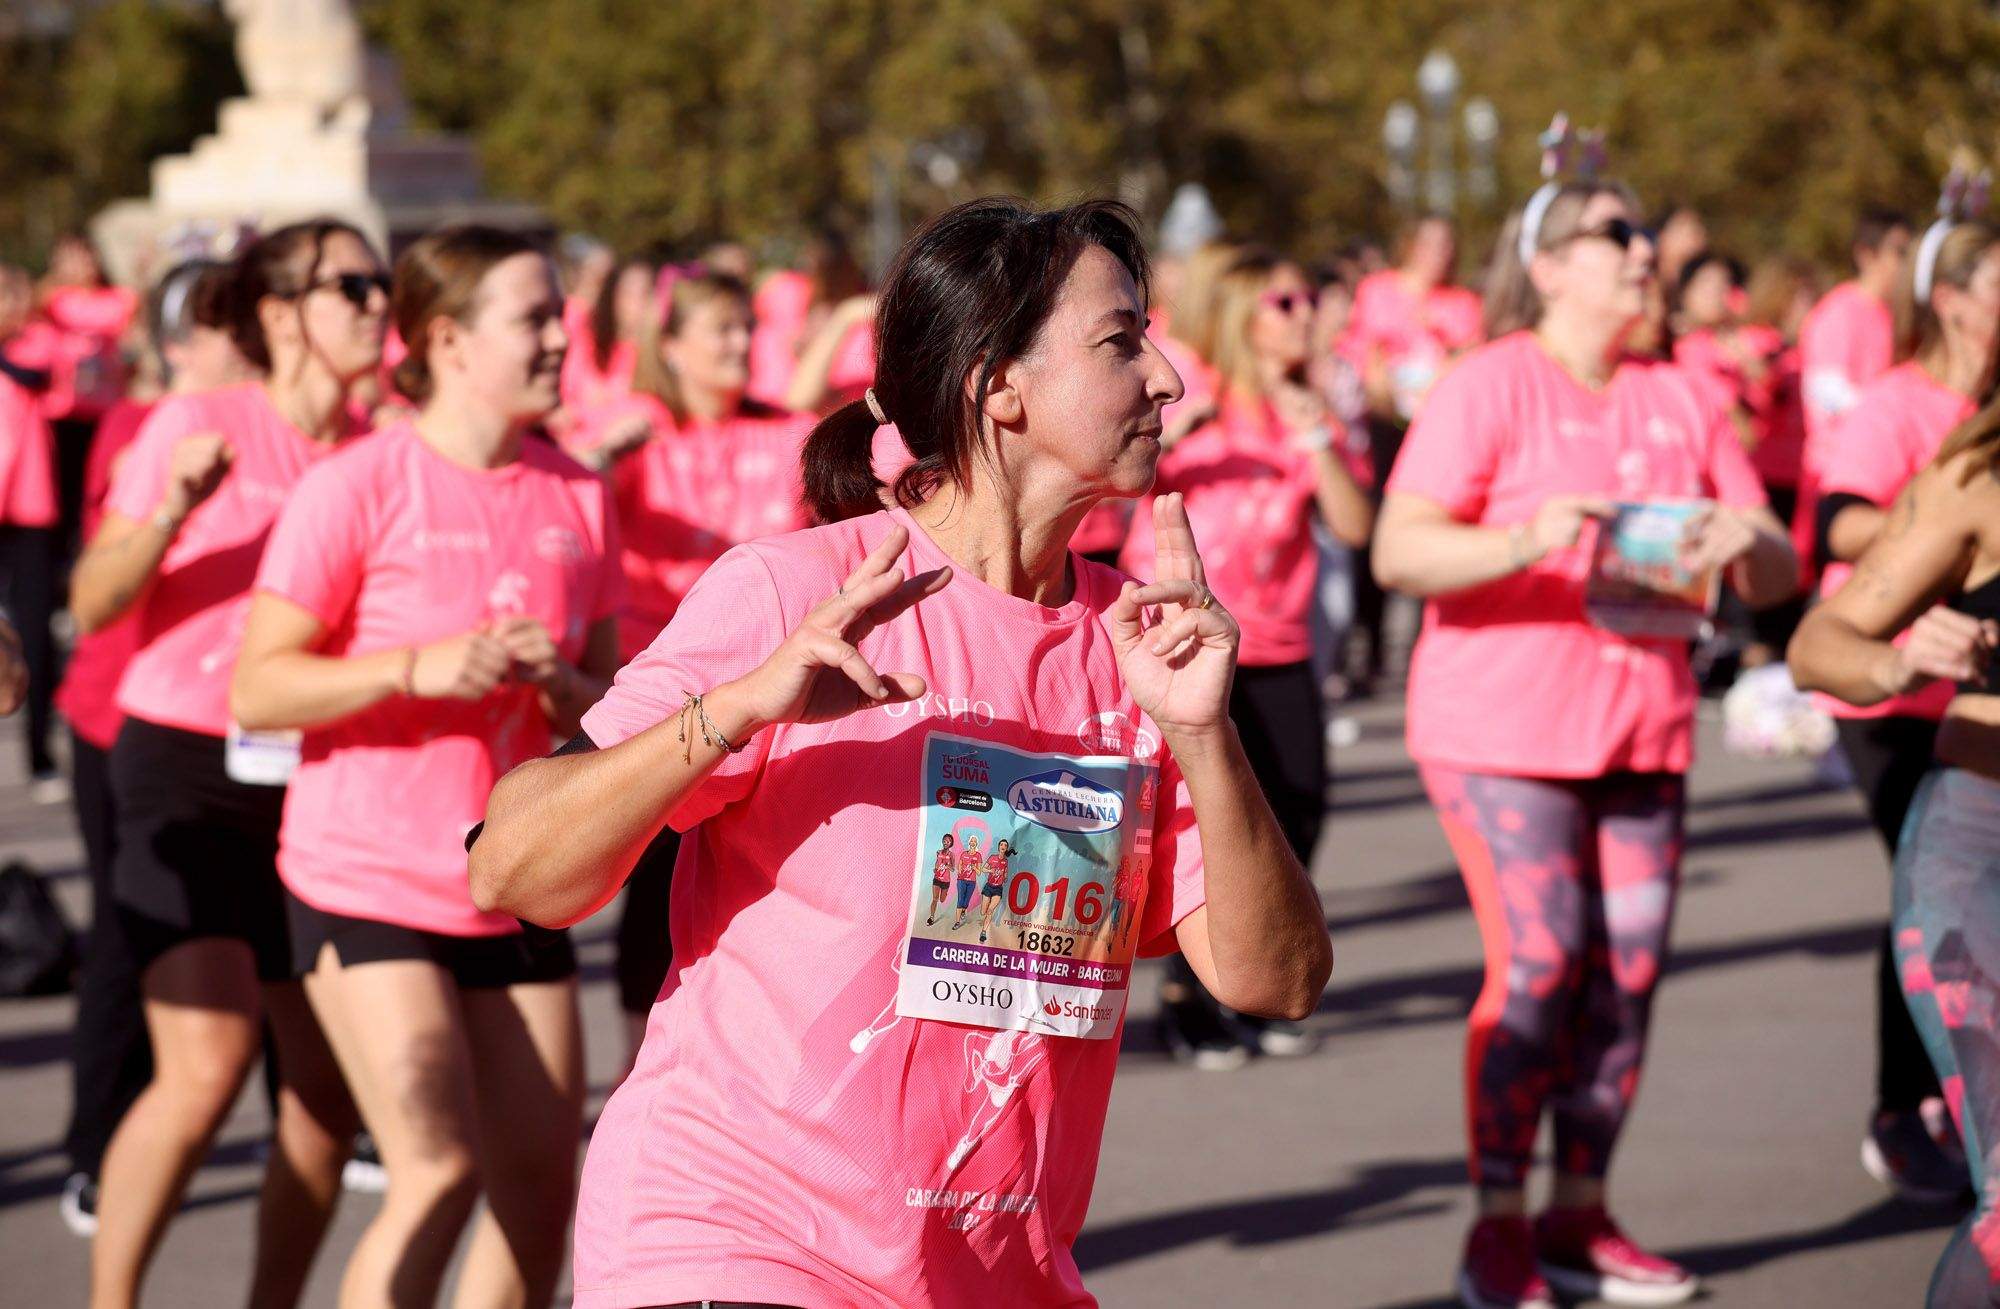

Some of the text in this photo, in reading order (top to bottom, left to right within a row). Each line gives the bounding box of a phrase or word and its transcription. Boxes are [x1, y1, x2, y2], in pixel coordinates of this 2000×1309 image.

[942, 765, 990, 784] SUMA
[956, 756, 991, 769] DORSAL
[959, 797, 987, 807] Barcelona
[1015, 789, 1119, 823] ASTURIANA
[1008, 872, 1105, 925] 016
[1017, 930, 1075, 956] 18632
[932, 946, 989, 966] CARRERA
[993, 953, 1007, 969] DE
[1010, 957, 1025, 971] LA
[1030, 959, 1069, 978] MUJER
[932, 980, 1013, 1009] OYSHO
